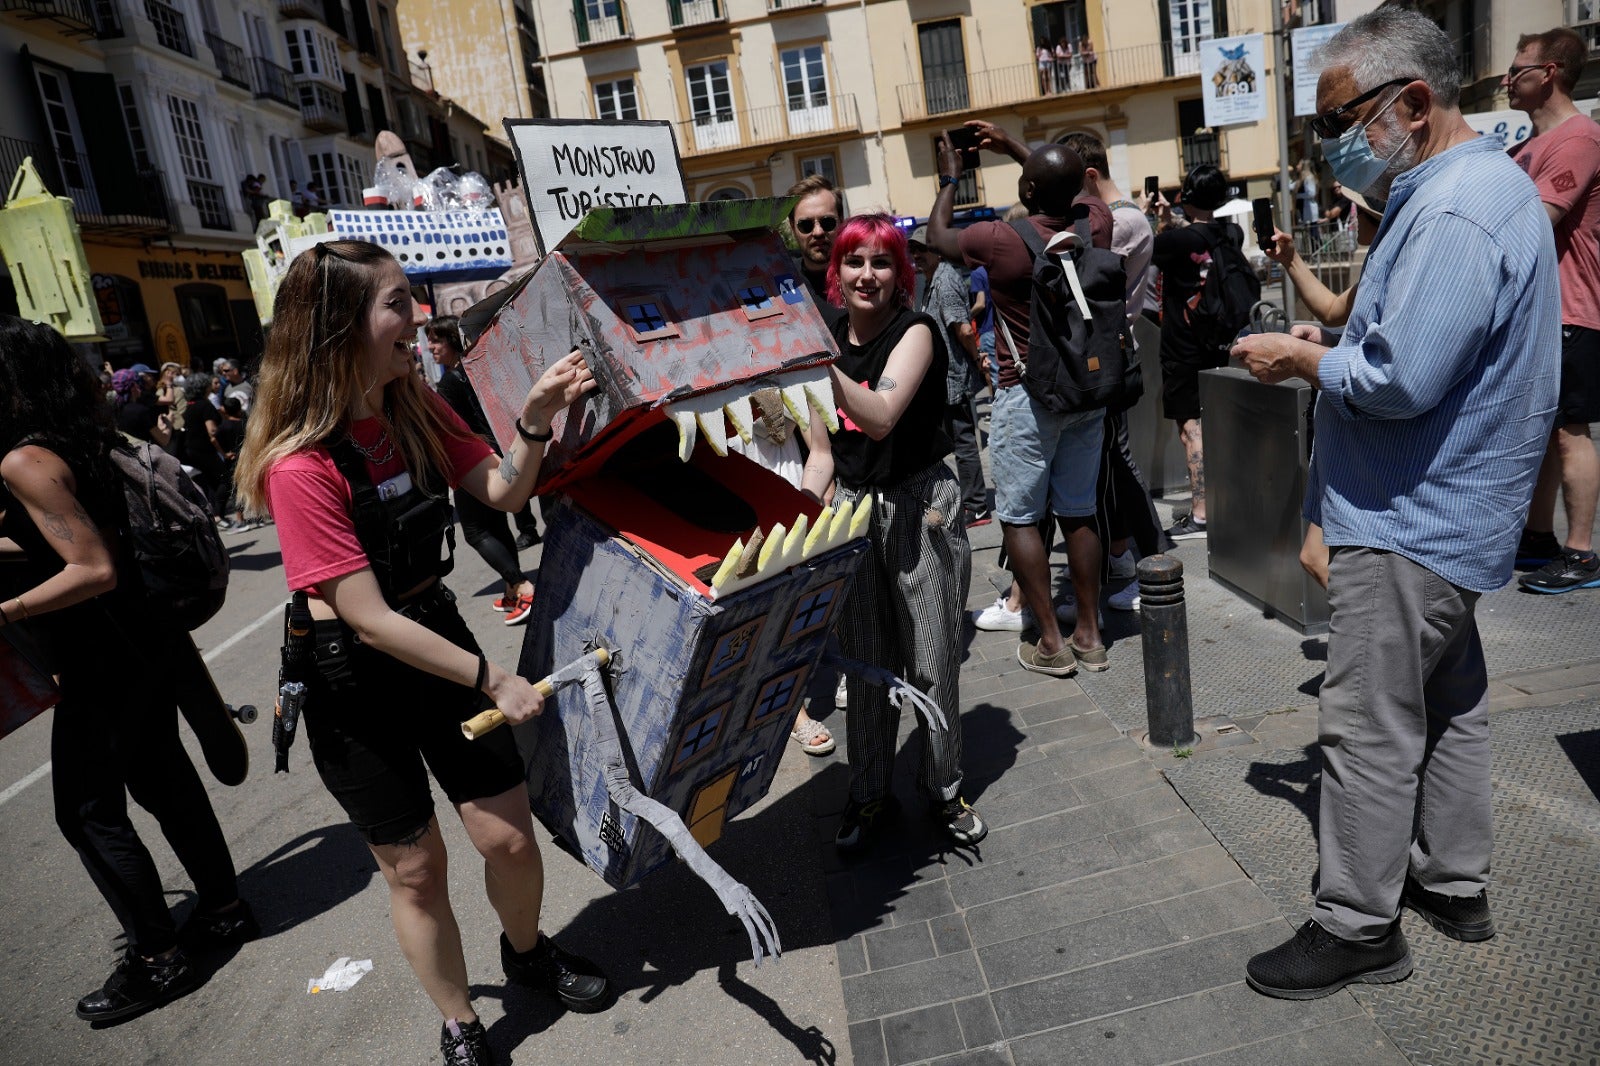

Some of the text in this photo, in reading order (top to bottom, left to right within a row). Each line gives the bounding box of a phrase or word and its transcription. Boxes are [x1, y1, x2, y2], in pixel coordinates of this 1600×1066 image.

[551, 143, 656, 178] MONSTRUO
[780, 278, 796, 295] AT
[741, 754, 764, 777] AT
[604, 814, 624, 837] MANI
